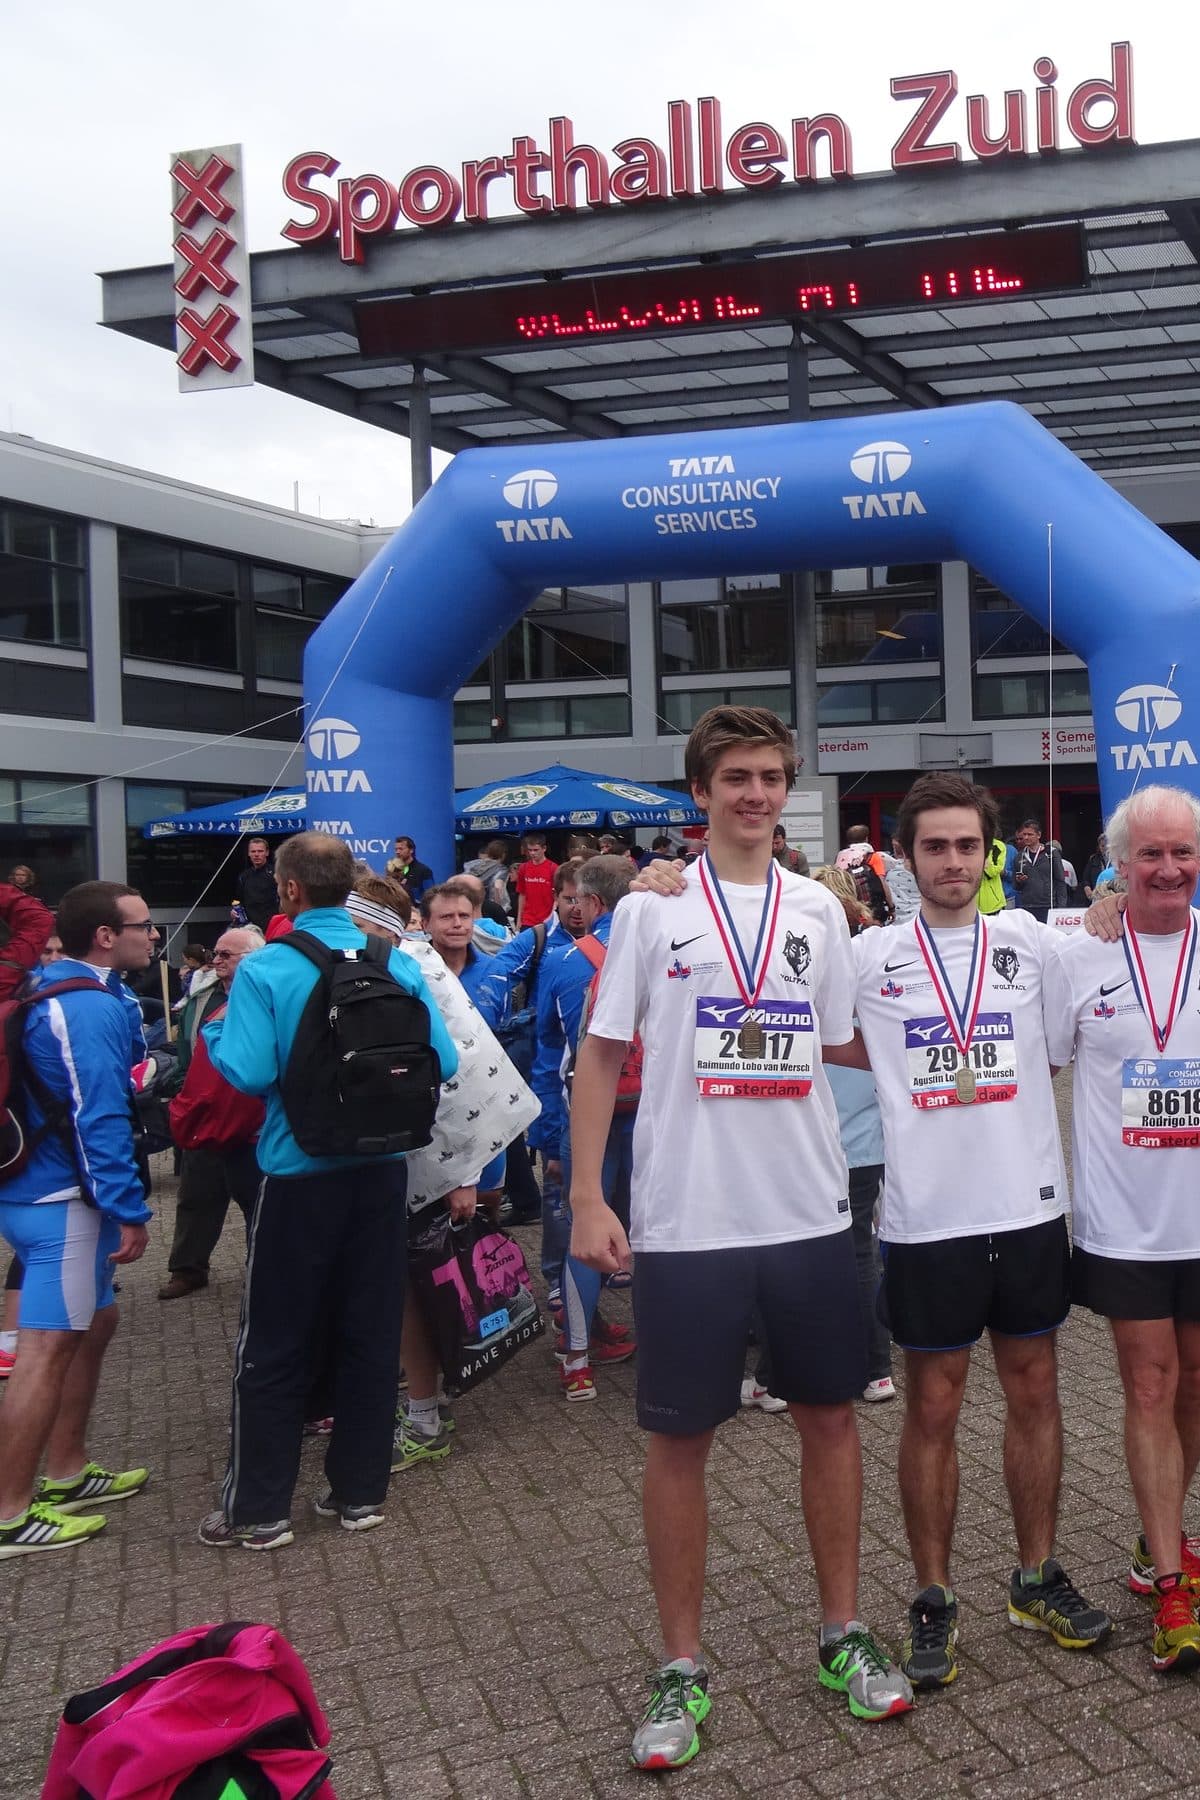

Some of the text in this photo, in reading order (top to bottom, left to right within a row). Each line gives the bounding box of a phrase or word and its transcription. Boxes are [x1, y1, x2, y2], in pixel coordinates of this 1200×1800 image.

[281, 41, 1137, 265] Sporthallen Zuid
[668, 455, 735, 478] TATA
[621, 476, 781, 510] CONSULTANCY
[842, 491, 927, 519] TATA
[496, 518, 573, 543] TATA
[654, 508, 758, 535] SERVICES
[818, 740, 869, 753] sterdam
[1056, 731, 1095, 743] Geme
[1056, 744, 1096, 756] Sporthall
[1110, 741, 1198, 770] TATA
[306, 769, 372, 793] TATA
[312, 821, 354, 835] TATA
[942, 1023, 1009, 1039] ZUNO
[697, 1060, 741, 1071] Raimundo
[742, 1062, 762, 1071] Lobo
[780, 1062, 810, 1072] Wersch
[983, 1069, 1014, 1079] Wersch
[1131, 1077, 1160, 1087] TATA
[1142, 1115, 1185, 1128] Rodrigo
[460, 1316, 545, 1379] WAVE RIDER
